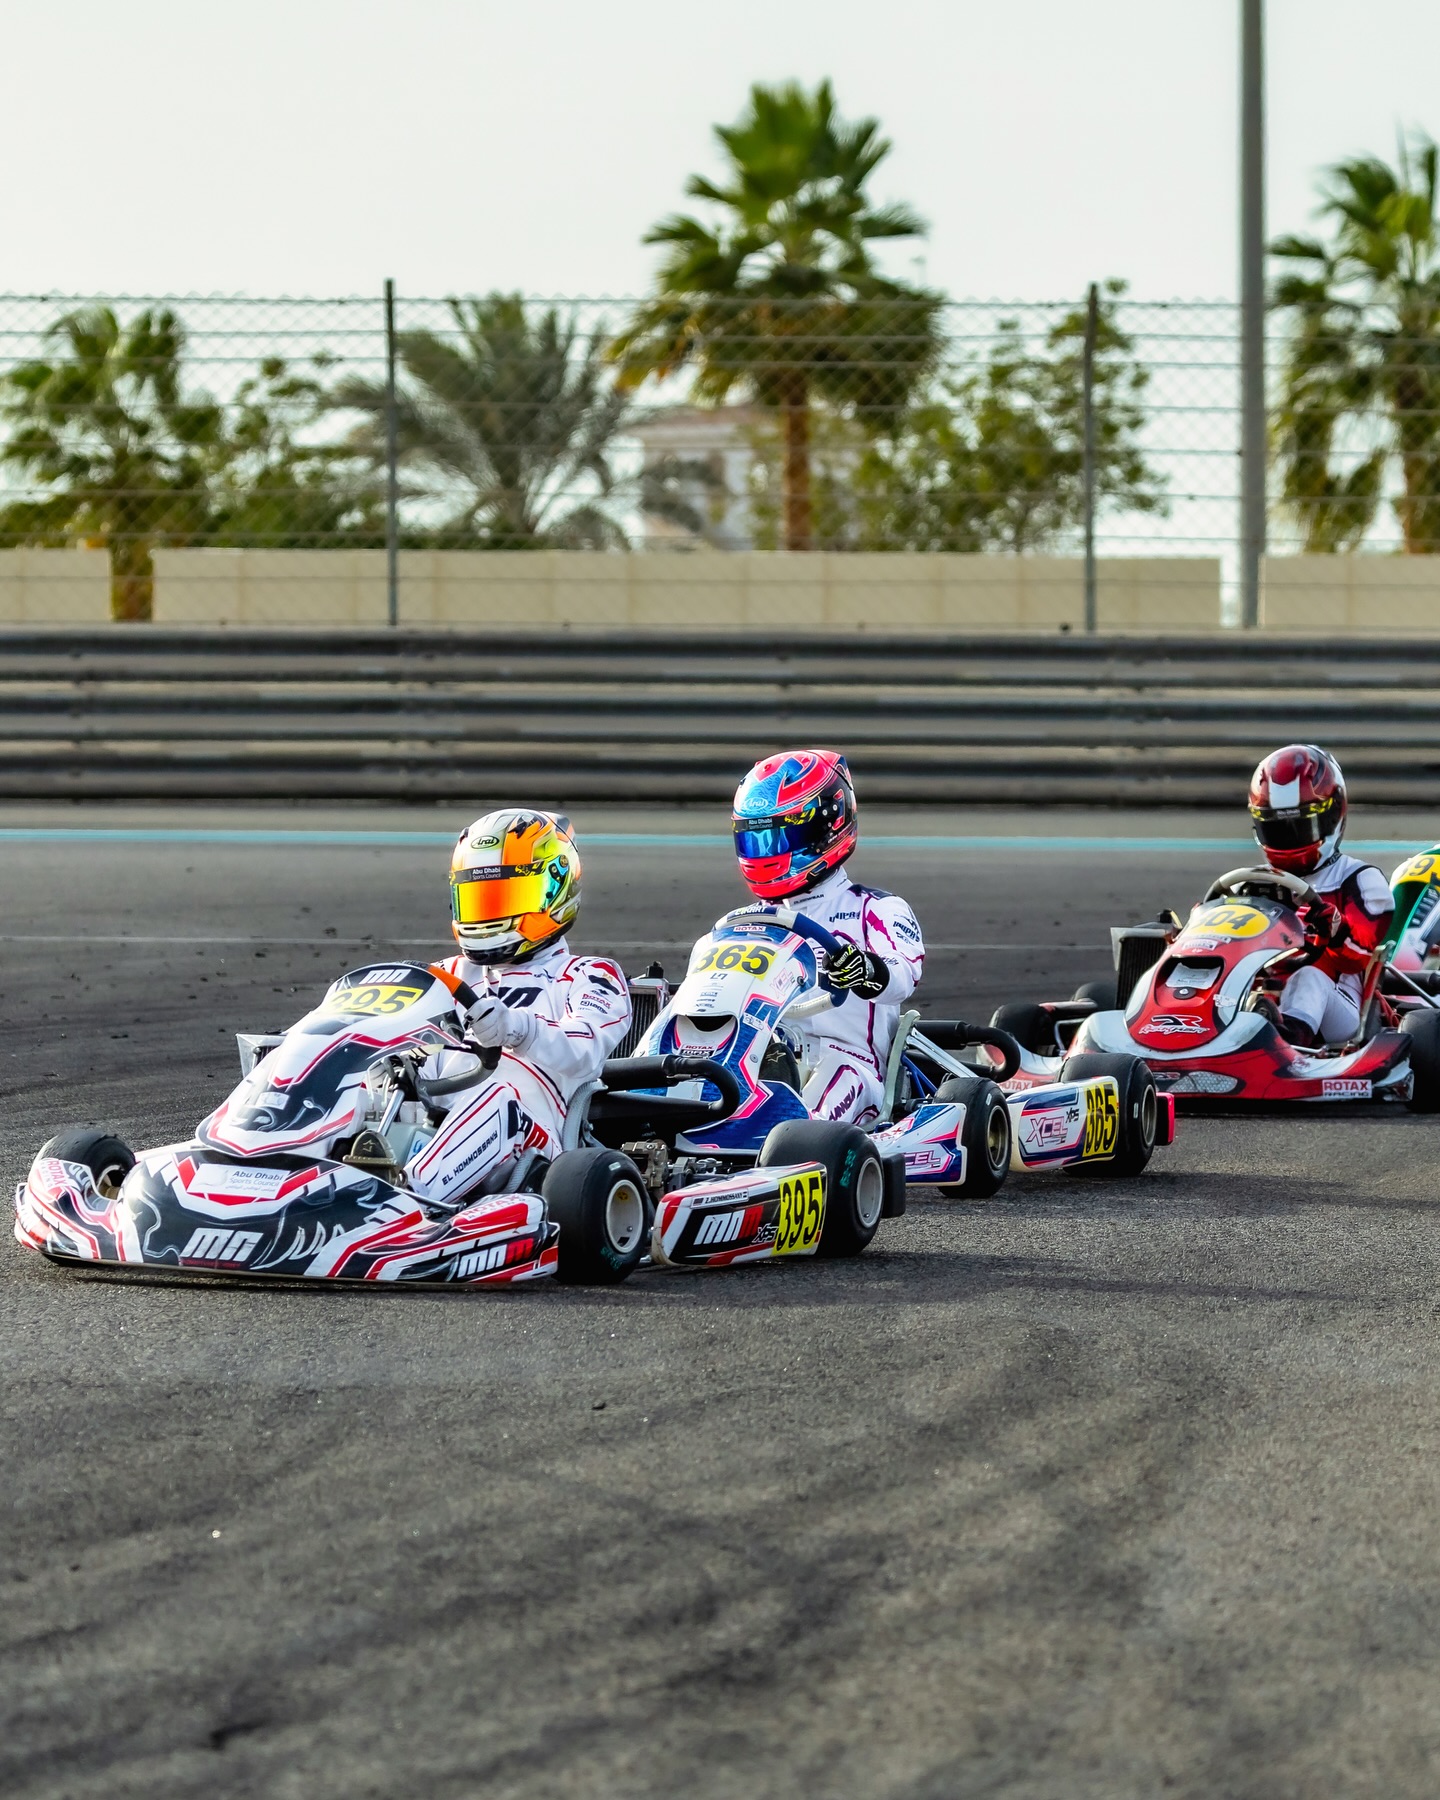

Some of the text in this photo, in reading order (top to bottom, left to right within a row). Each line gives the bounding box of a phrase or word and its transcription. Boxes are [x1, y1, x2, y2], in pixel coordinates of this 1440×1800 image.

[693, 944, 777, 976] 365
[330, 988, 417, 1014] 395
[1323, 1081, 1369, 1091] ROTAX
[1086, 1083, 1116, 1153] 365
[1026, 1116, 1069, 1147] XCEL
[904, 1150, 941, 1166] CEL
[47, 1160, 68, 1186] ROTAX
[254, 1172, 284, 1181] Dhabi
[442, 1176, 454, 1186] EL
[462, 1195, 520, 1216] ROTAX
[776, 1176, 821, 1252] 395
[752, 1223, 779, 1244] XPS
